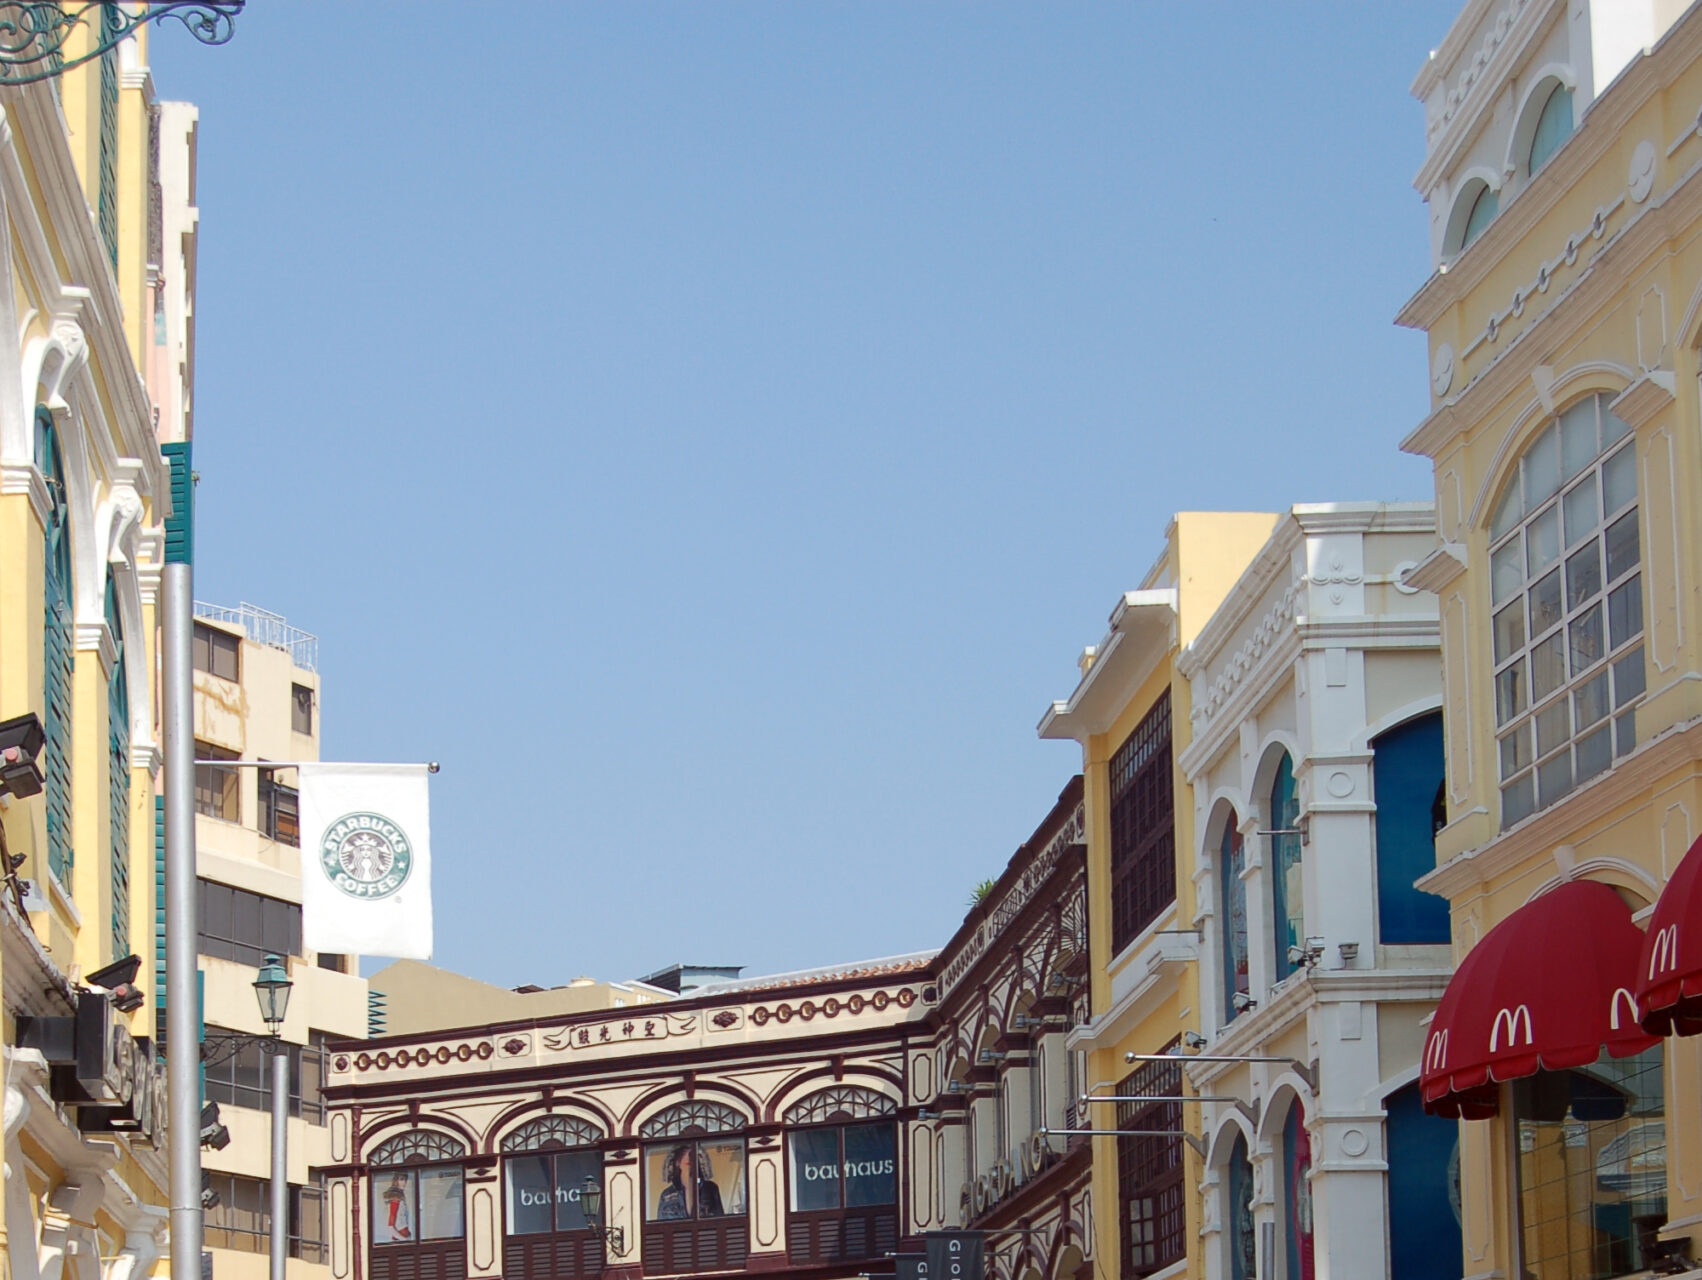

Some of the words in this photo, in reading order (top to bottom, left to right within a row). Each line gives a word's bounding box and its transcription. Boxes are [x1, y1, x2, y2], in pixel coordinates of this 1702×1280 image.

[325, 816, 407, 853] STARBUCKS
[335, 872, 400, 897] COFFEE
[804, 1159, 894, 1181] bauhaus
[520, 1186, 581, 1207] bauha
